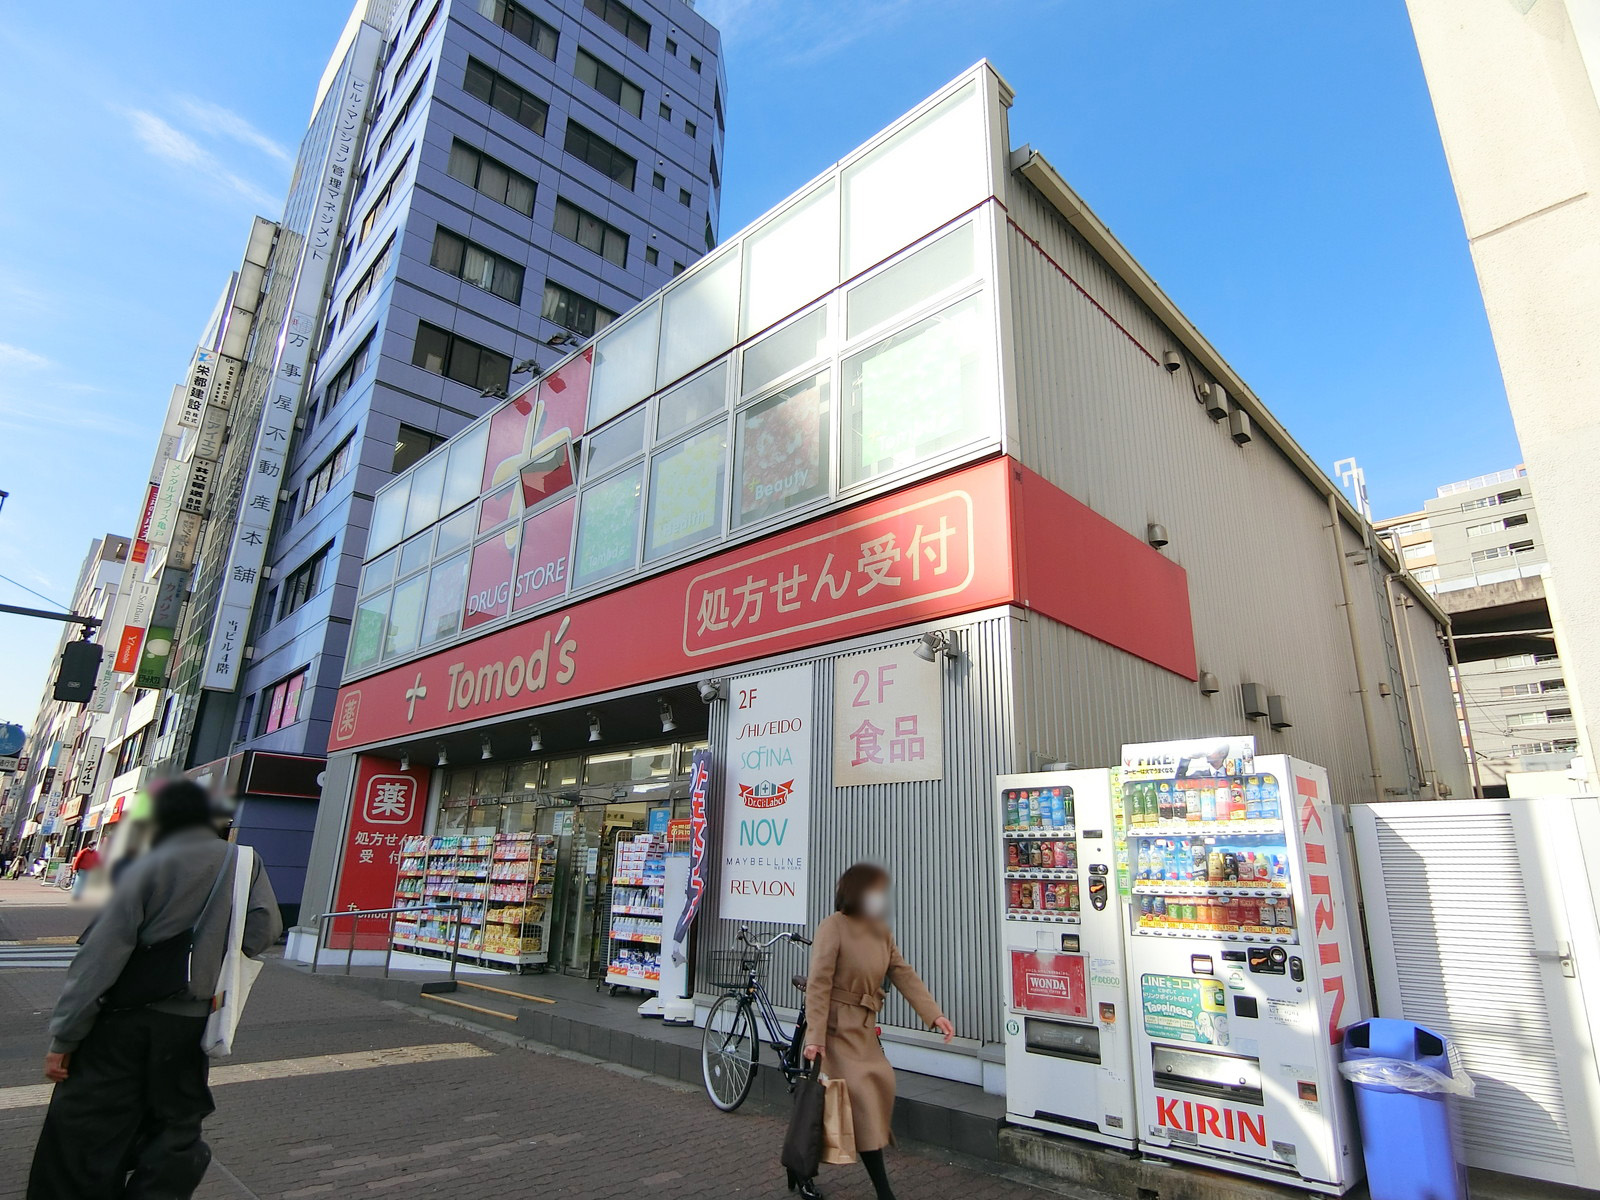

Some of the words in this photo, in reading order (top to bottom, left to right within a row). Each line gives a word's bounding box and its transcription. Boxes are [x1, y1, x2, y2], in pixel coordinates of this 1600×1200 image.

[755, 469, 808, 500] Beauty
[468, 581, 509, 616] DRUG
[515, 557, 566, 598] STORE
[697, 516, 957, 637] 処方せん受付
[133, 594, 146, 624] SoftBank
[447, 615, 578, 712] Tomod's
[738, 688, 758, 710] 2F
[852, 664, 897, 707] 2F
[736, 717, 802, 740] SHISEIDO
[849, 715, 925, 767] 食品
[372, 782, 408, 816] 薬
[740, 818, 788, 846] NOV
[726, 857, 802, 867] MAYBELLINE
[730, 879, 795, 896] REVLON
[1030, 977, 1066, 990] WONDA
[1156, 1095, 1267, 1147] KIRIN
